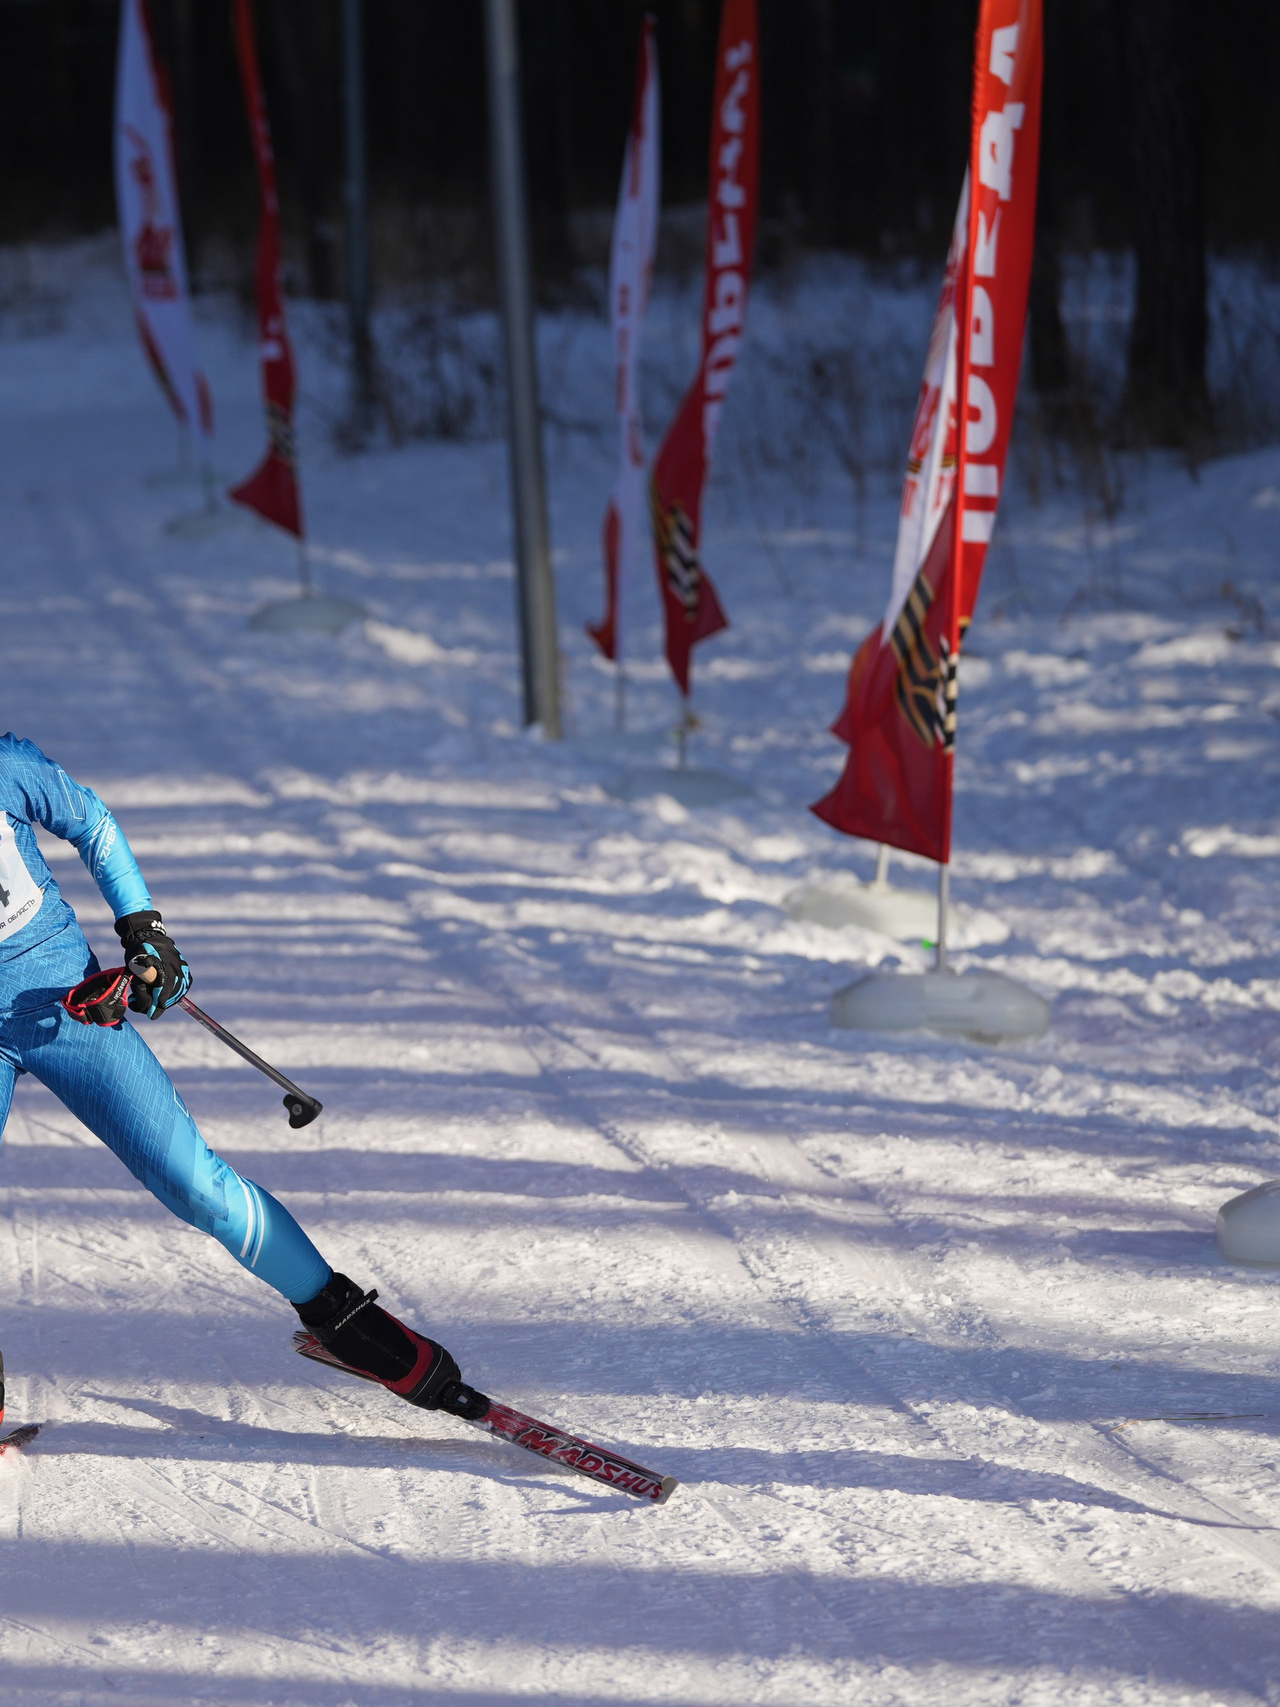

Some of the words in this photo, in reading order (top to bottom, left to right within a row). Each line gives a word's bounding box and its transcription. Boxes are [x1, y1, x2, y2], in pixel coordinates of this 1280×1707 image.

[7, 899, 36, 924] ОБЛАСТЬ
[334, 1299, 371, 1331] MADSHUS
[517, 1427, 664, 1500] MADSHUS
